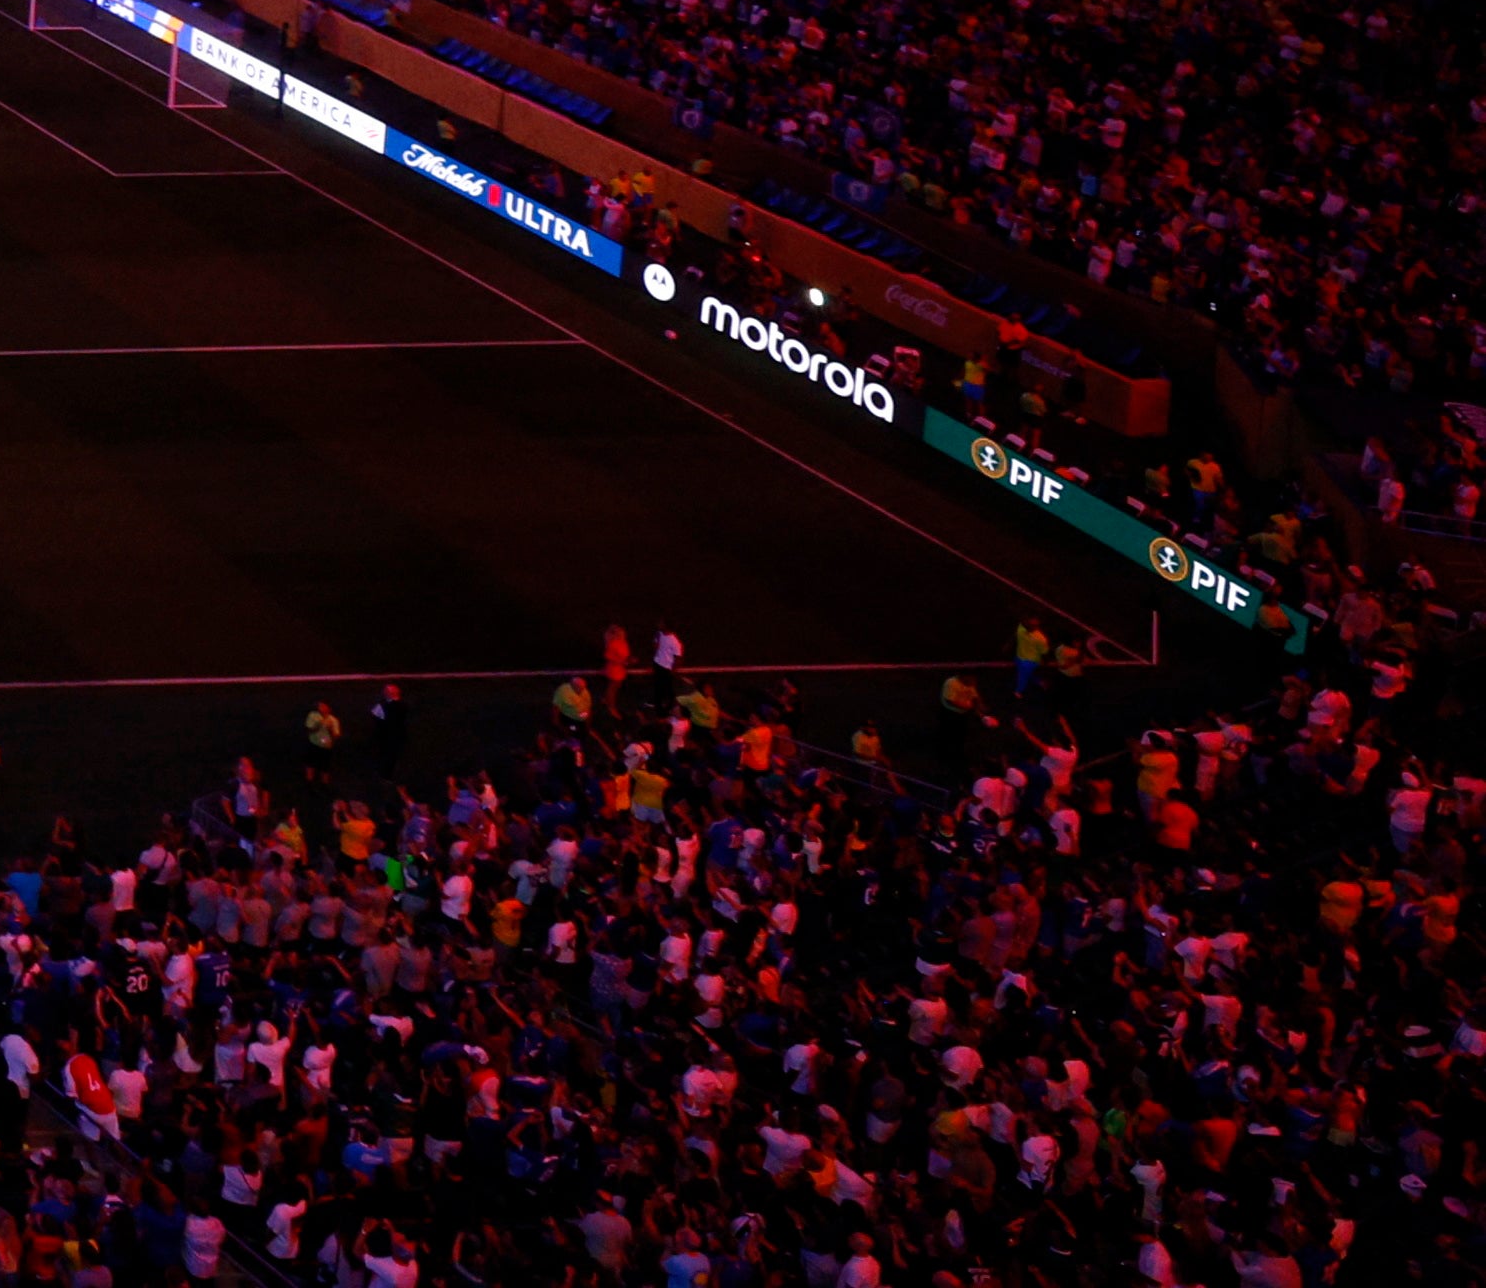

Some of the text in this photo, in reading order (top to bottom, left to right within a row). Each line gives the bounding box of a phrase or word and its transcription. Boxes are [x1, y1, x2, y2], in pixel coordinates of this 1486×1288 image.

[195, 37, 352, 129] BANK OF AMERICA
[504, 190, 594, 258] ULTRA
[700, 296, 895, 423] motorola
[1009, 459, 1063, 504] PIF
[1192, 561, 1250, 611] PIF
